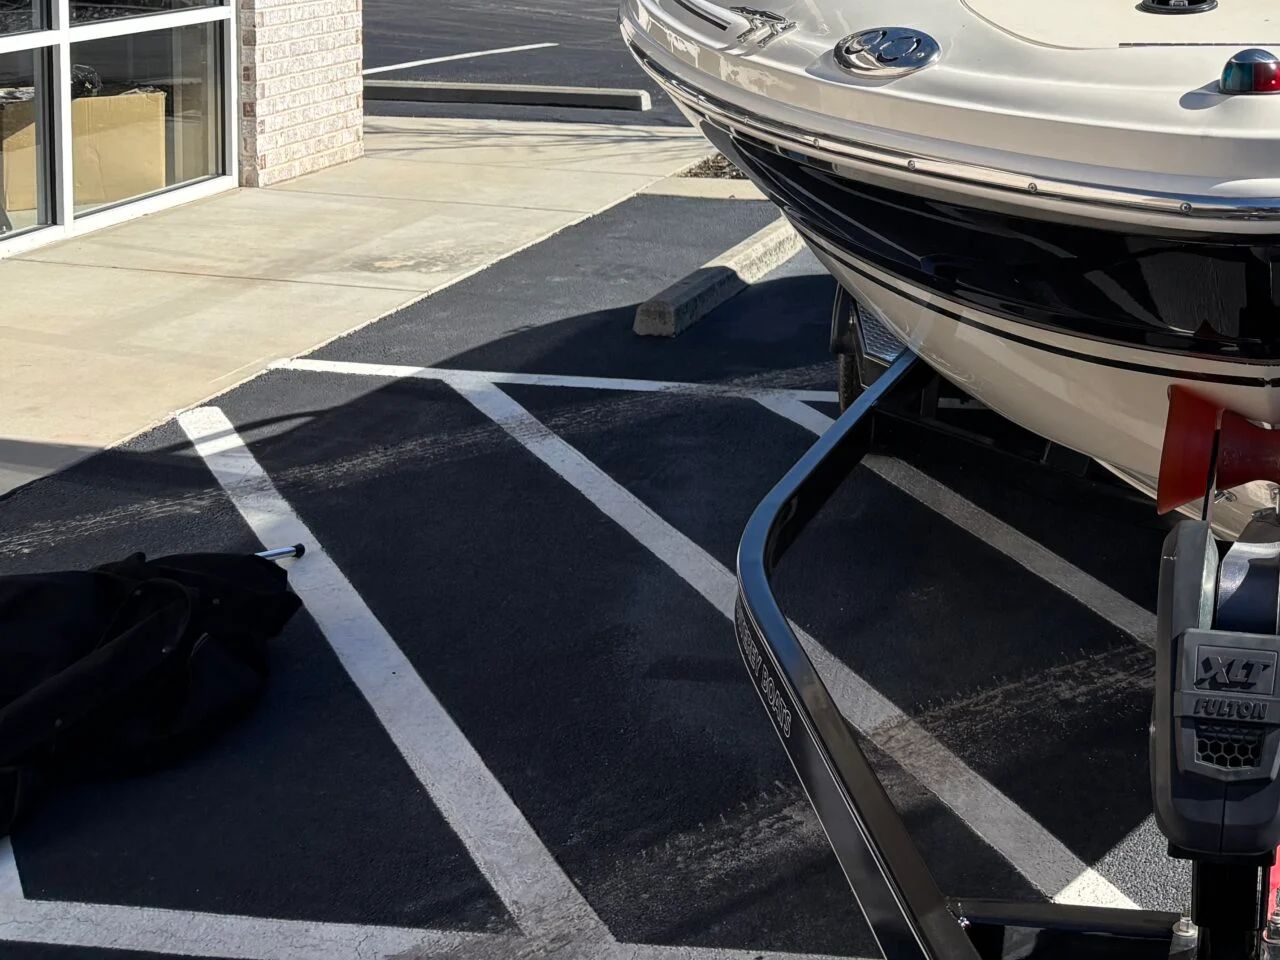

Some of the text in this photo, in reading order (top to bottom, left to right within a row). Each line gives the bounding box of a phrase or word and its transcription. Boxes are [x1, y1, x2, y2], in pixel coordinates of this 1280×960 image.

[1194, 656, 1274, 689] XLT
[761, 664, 792, 739] BOATS
[1193, 697, 1269, 720] FULTON
